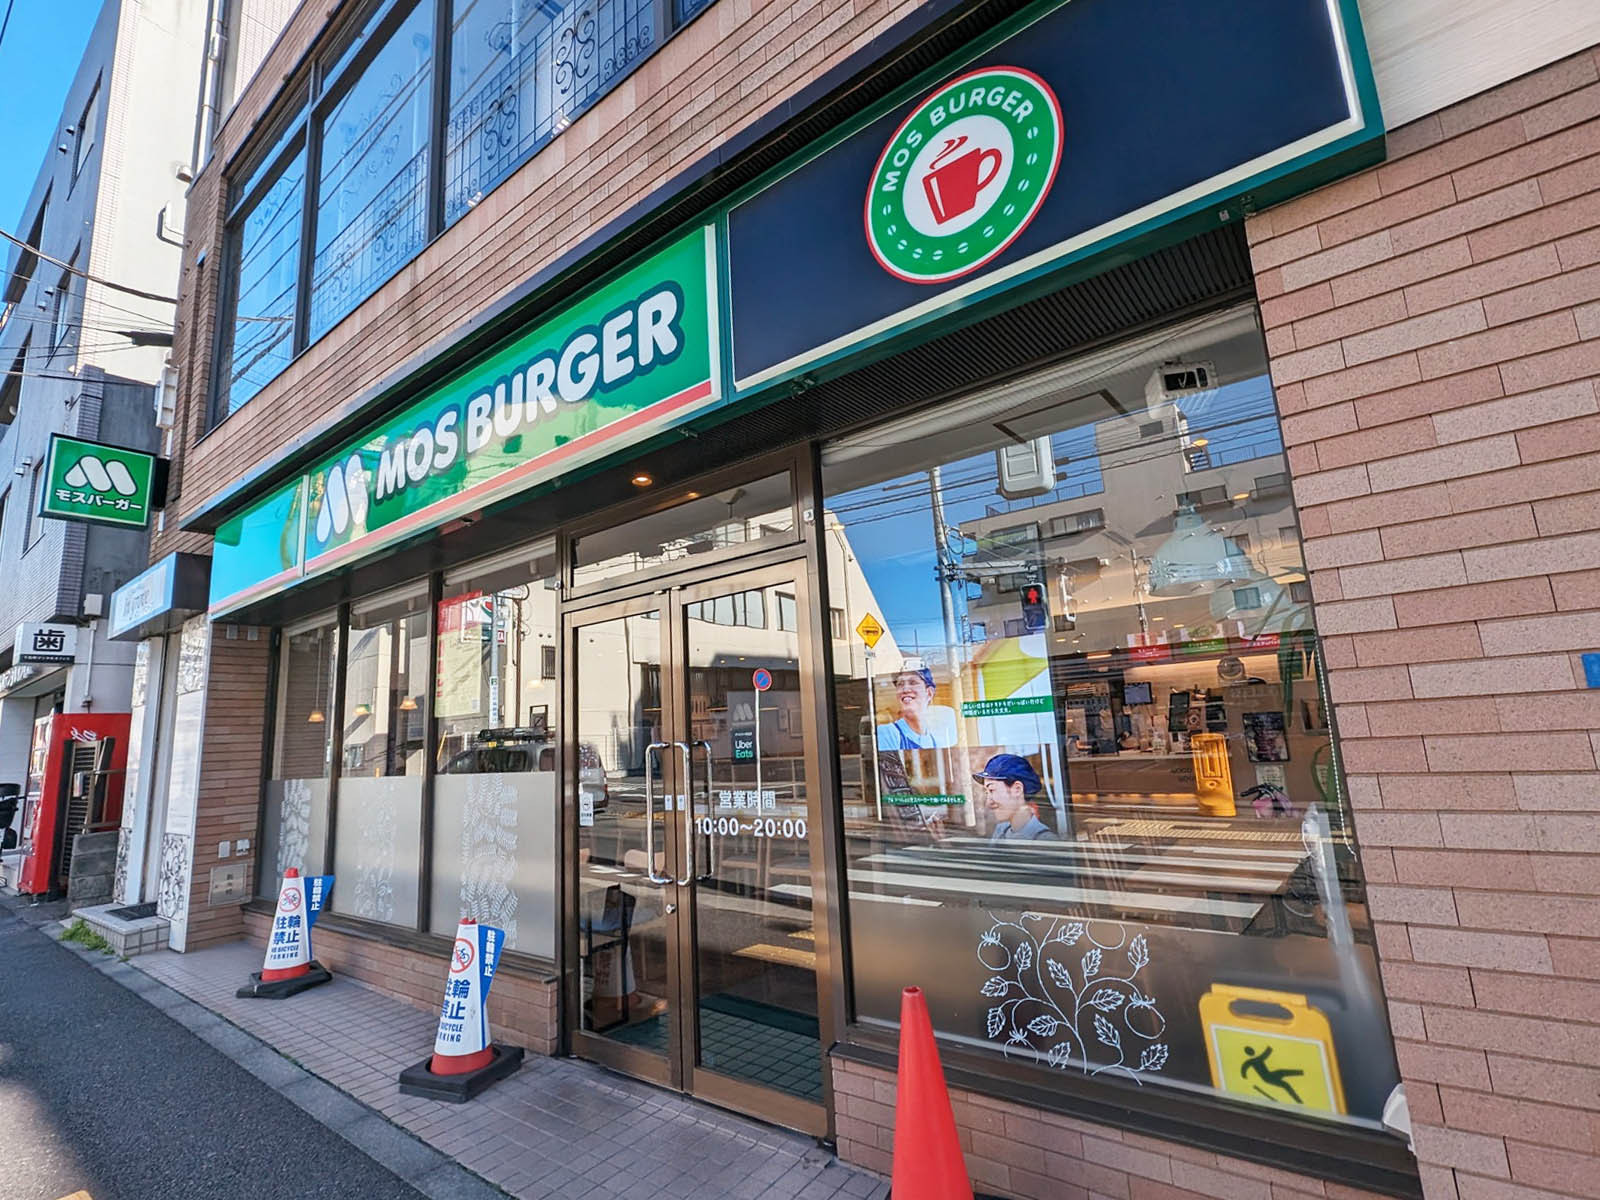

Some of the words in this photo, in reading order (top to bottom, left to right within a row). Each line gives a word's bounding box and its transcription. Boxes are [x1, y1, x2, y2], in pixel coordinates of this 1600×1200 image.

[882, 130, 923, 192] MOS
[929, 86, 1034, 127] BURGER
[375, 411, 459, 500] MOS
[466, 290, 678, 454] BURGER
[55, 489, 143, 510] モスバーガー
[33, 629, 66, 652] 歯
[735, 740, 753, 749] Uber
[735, 750, 754, 759] Eats
[719, 790, 776, 809] 営業時間
[273, 930, 300, 945] 禁止
